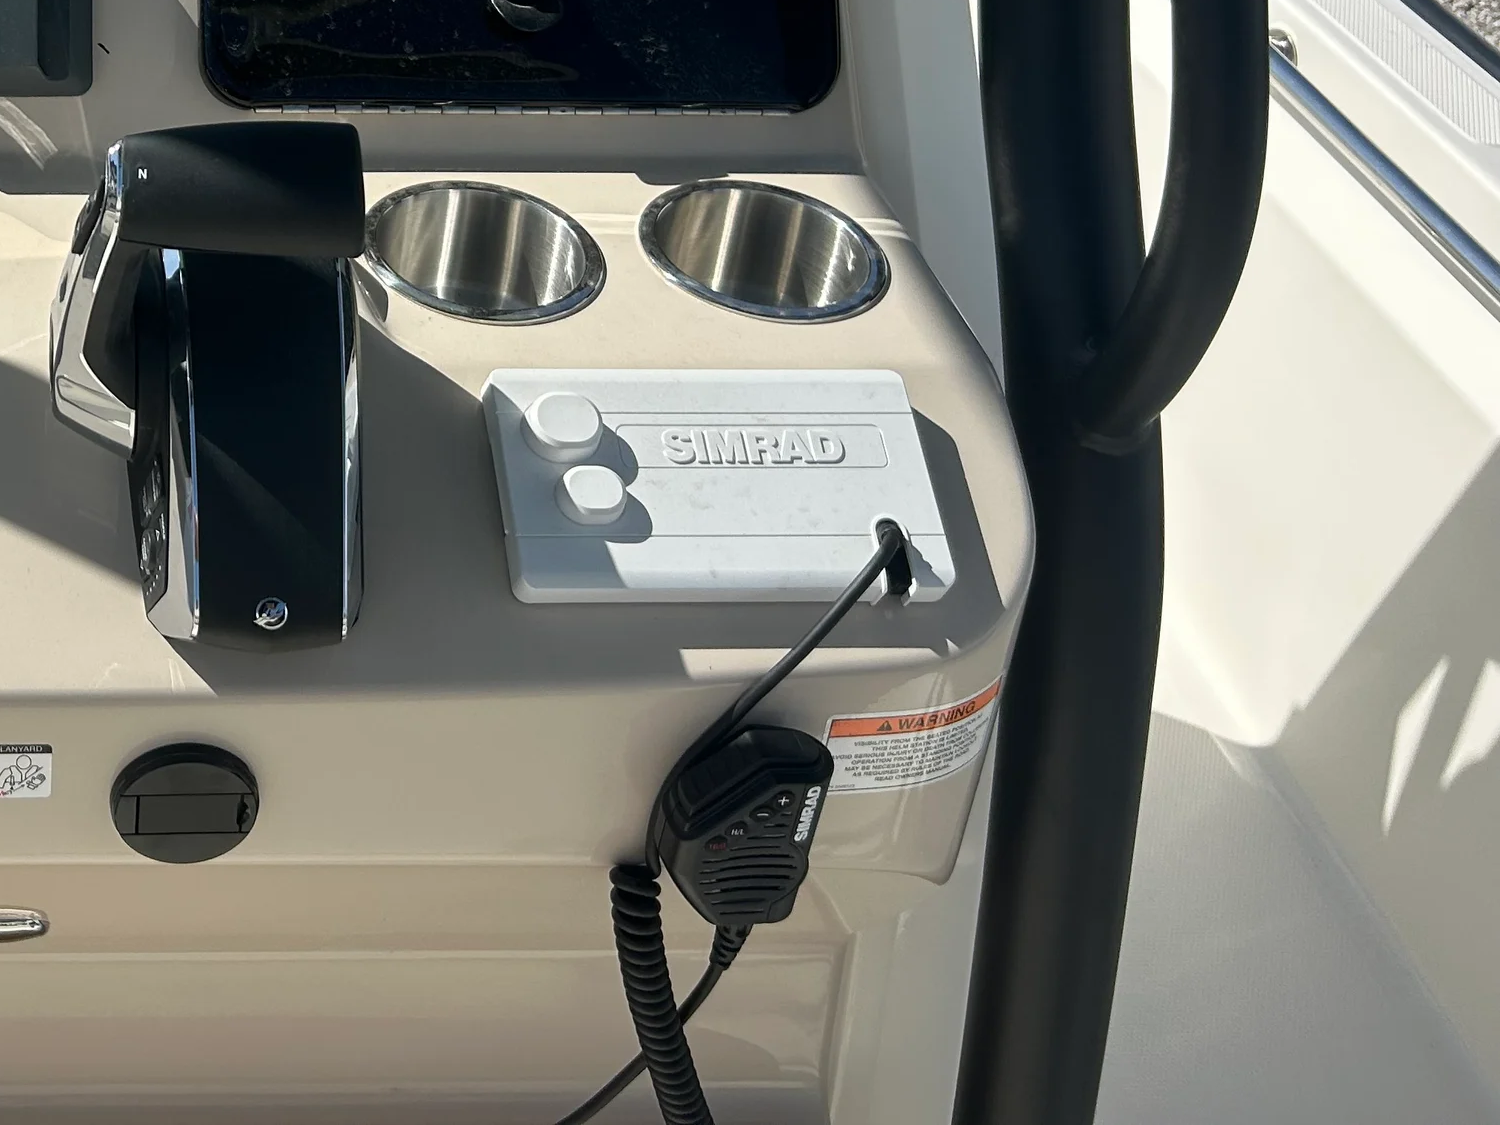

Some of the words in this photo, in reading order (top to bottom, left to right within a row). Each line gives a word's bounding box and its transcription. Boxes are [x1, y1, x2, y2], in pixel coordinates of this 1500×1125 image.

[138, 169, 148, 179] N
[661, 428, 846, 466] SIMRAD
[899, 701, 976, 729] WARNING
[794, 785, 821, 842] SIMRAD
